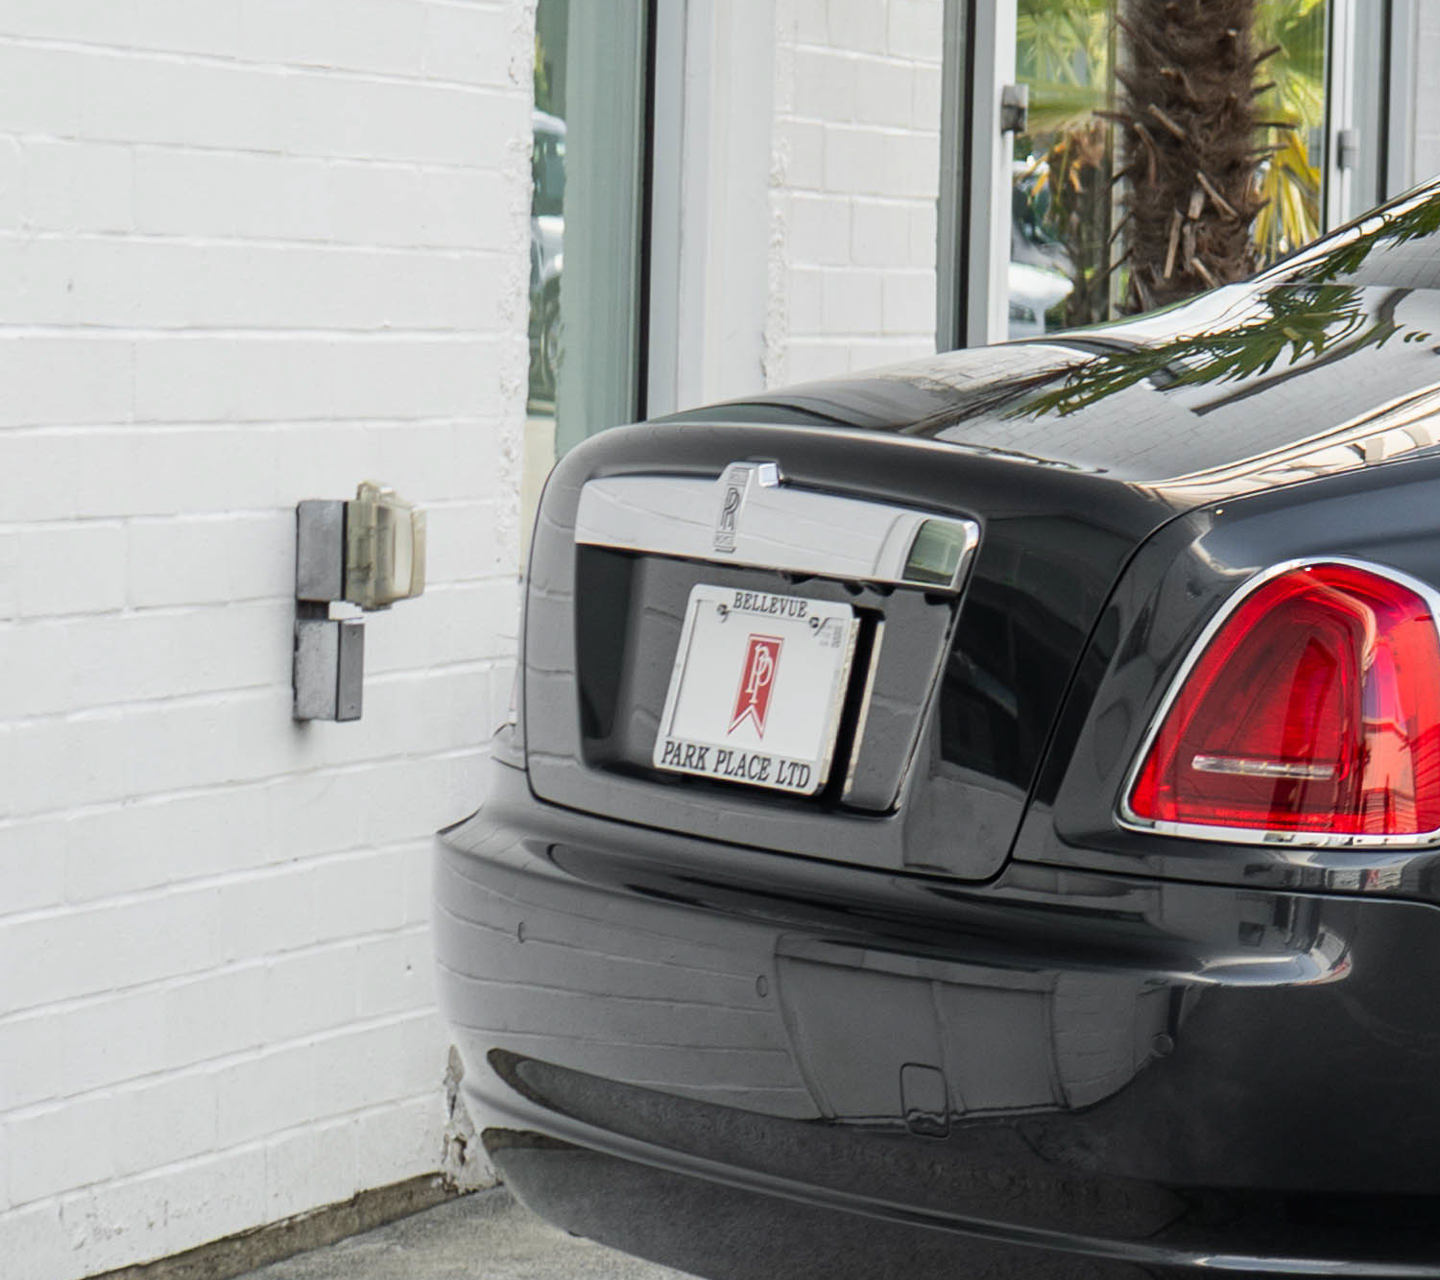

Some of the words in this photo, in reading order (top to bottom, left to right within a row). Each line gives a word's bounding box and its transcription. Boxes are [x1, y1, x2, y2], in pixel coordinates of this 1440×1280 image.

[733, 591, 809, 618] BELLEVUE
[661, 741, 710, 771] PARK
[713, 749, 771, 782] PLACE
[775, 760, 811, 789] LTD
